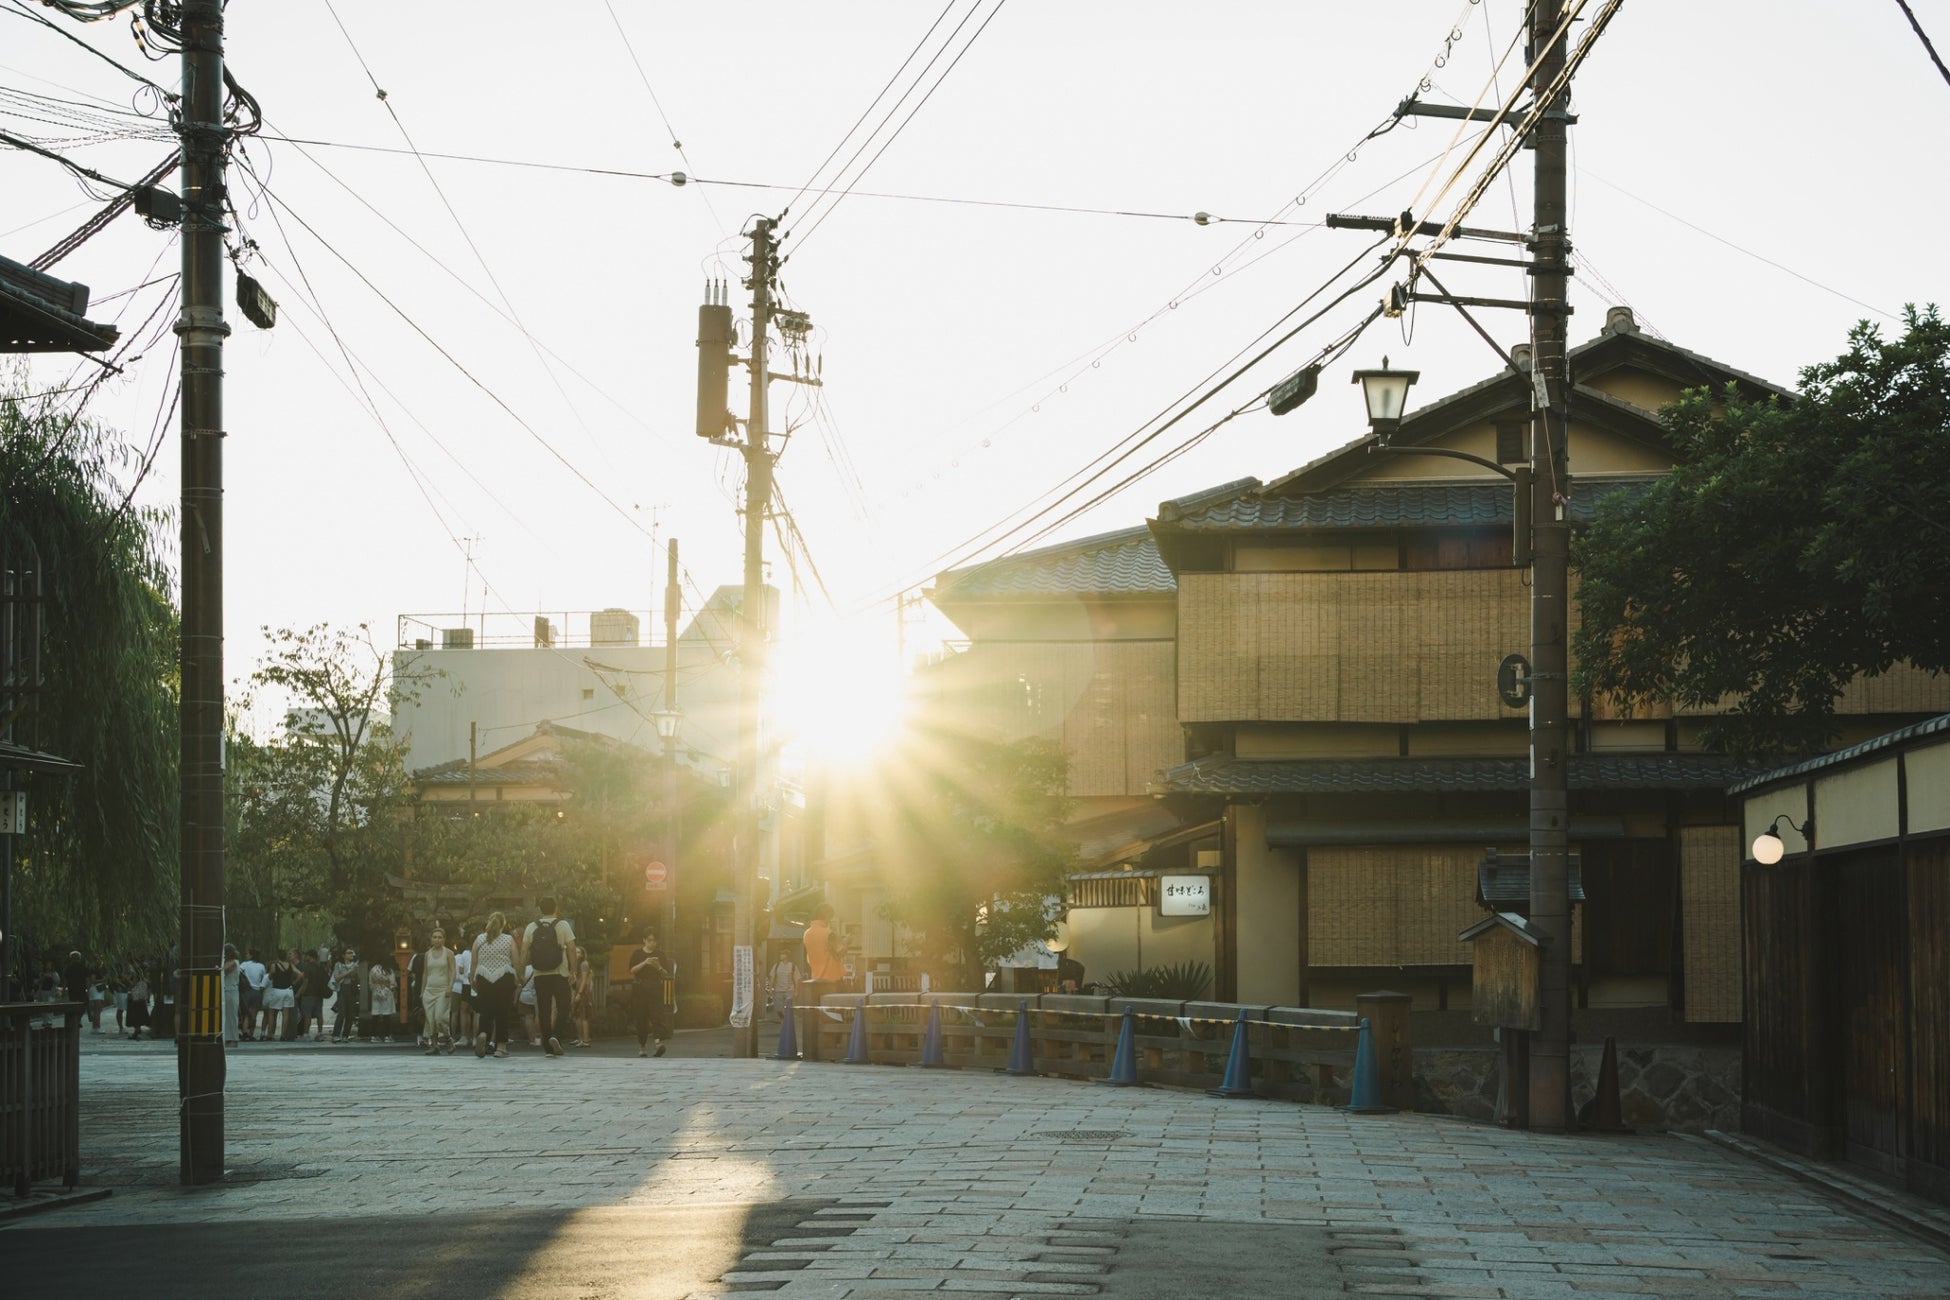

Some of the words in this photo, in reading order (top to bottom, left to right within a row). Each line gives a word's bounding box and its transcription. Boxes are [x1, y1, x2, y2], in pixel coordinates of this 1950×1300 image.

[1166, 883, 1205, 896] 甘味どころ
